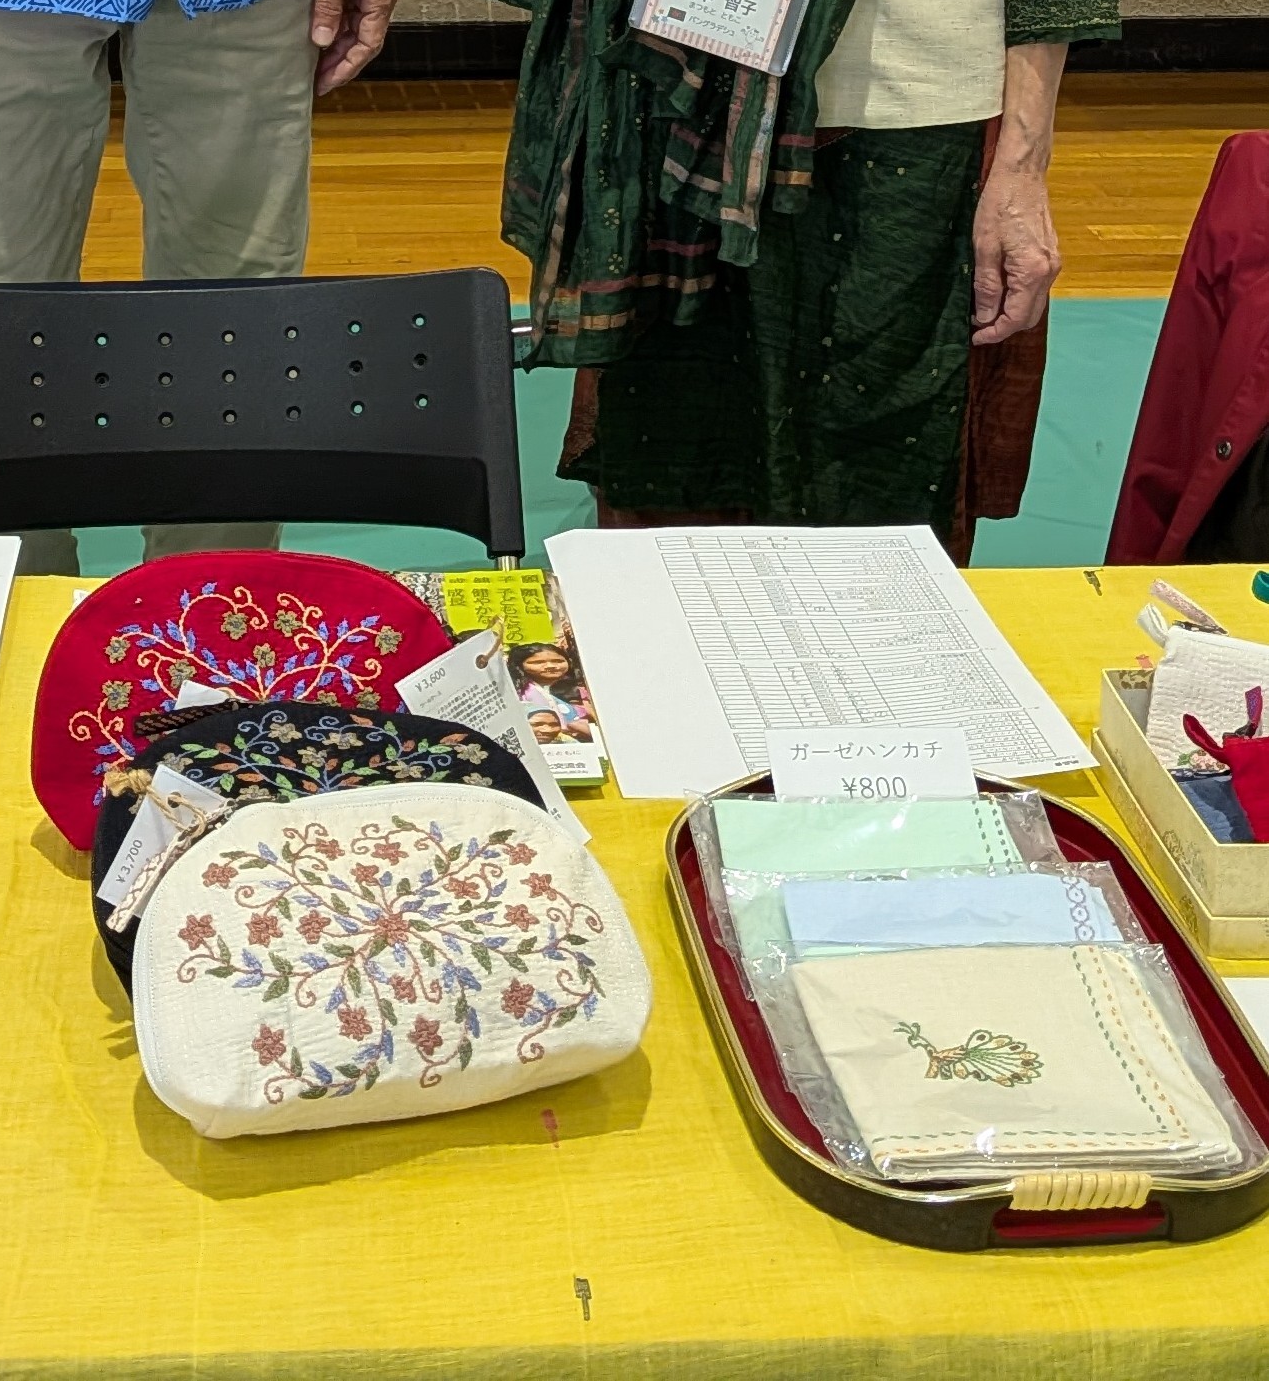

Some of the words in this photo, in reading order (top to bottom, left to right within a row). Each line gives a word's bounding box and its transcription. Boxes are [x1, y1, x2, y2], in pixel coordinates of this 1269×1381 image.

[789, 742, 944, 761] ガーゼハンカチ
[841, 776, 907, 800] ¥800
